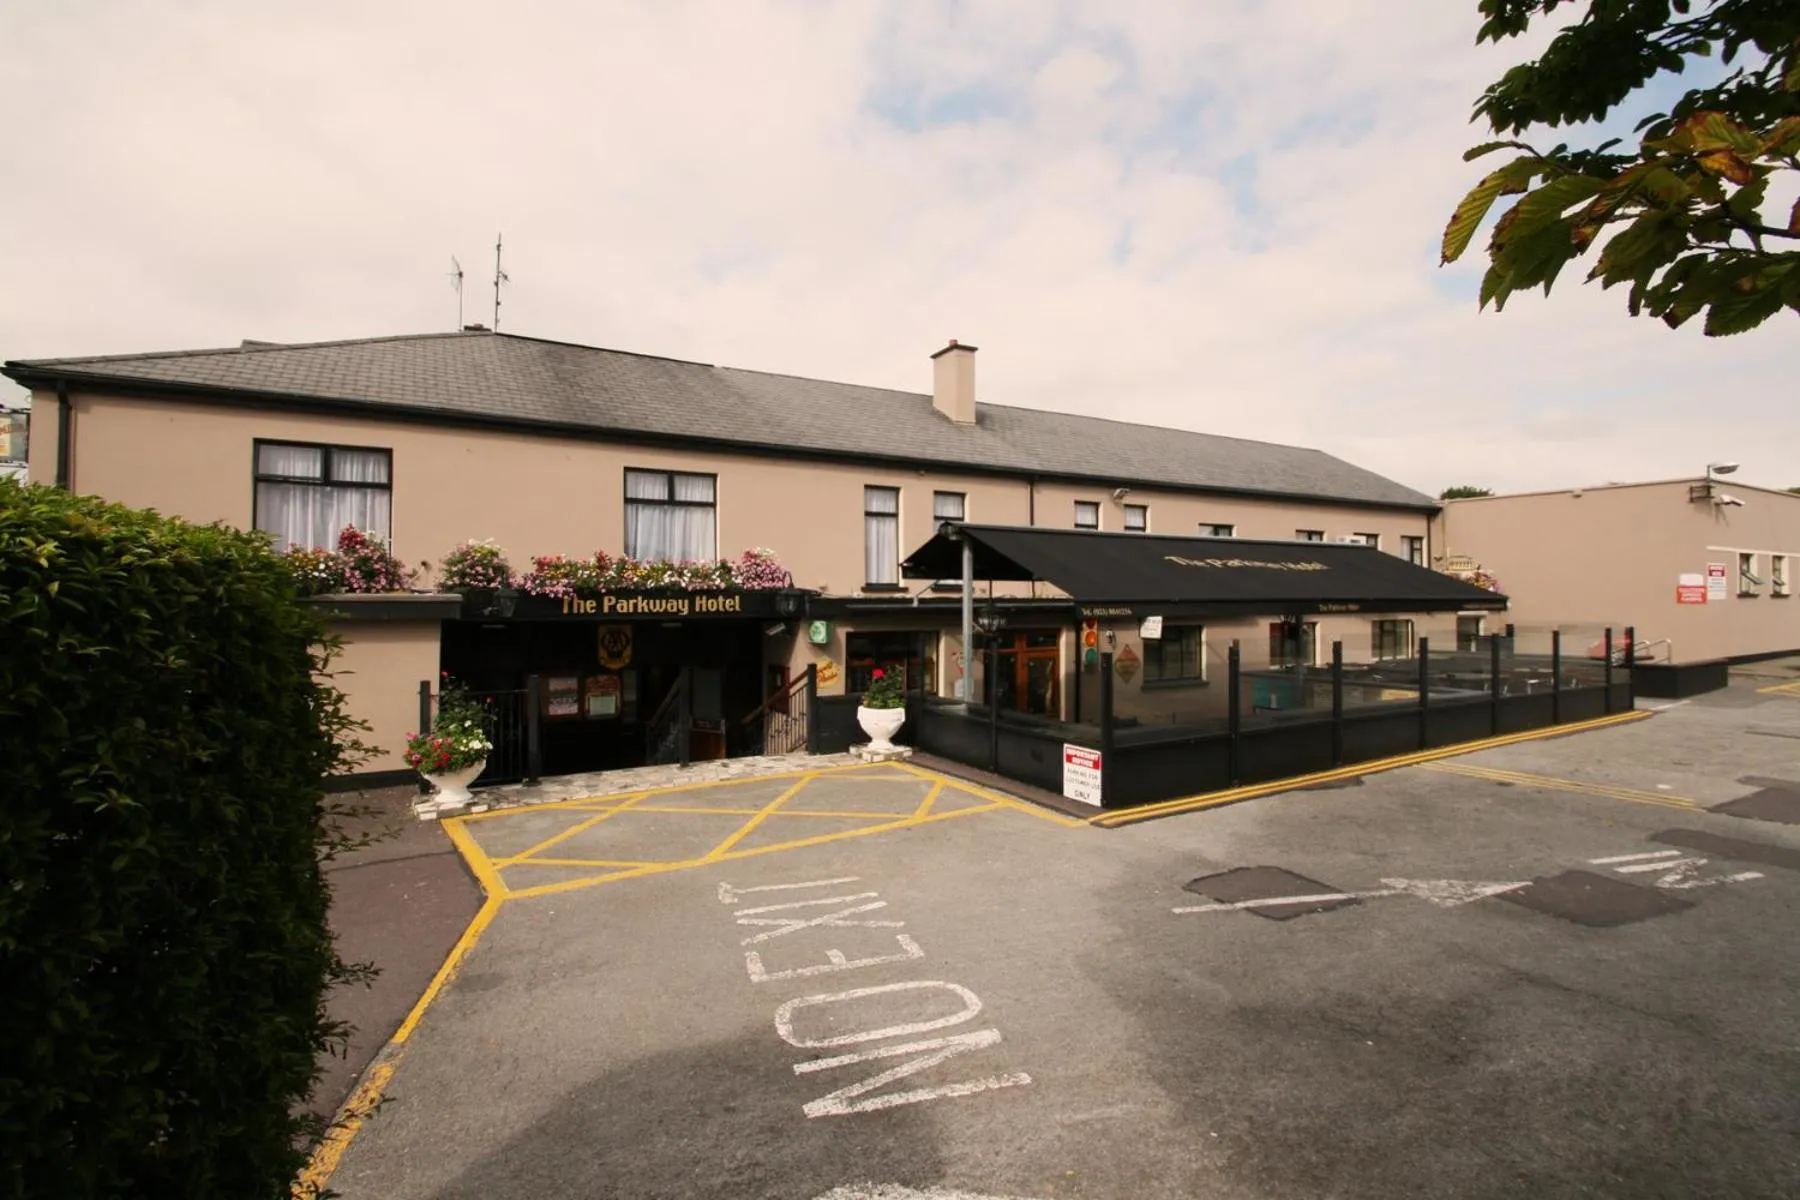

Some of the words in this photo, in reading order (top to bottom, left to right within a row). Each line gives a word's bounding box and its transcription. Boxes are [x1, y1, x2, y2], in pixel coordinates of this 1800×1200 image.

[562, 595, 597, 614] The
[602, 595, 690, 616] Parkway
[694, 595, 742, 613] Hotel
[1066, 747, 1100, 761] IMPORTANT
[1071, 757, 1094, 768] NOTICE
[1074, 790, 1090, 800] ONLY
[774, 980, 1032, 1119] NO
